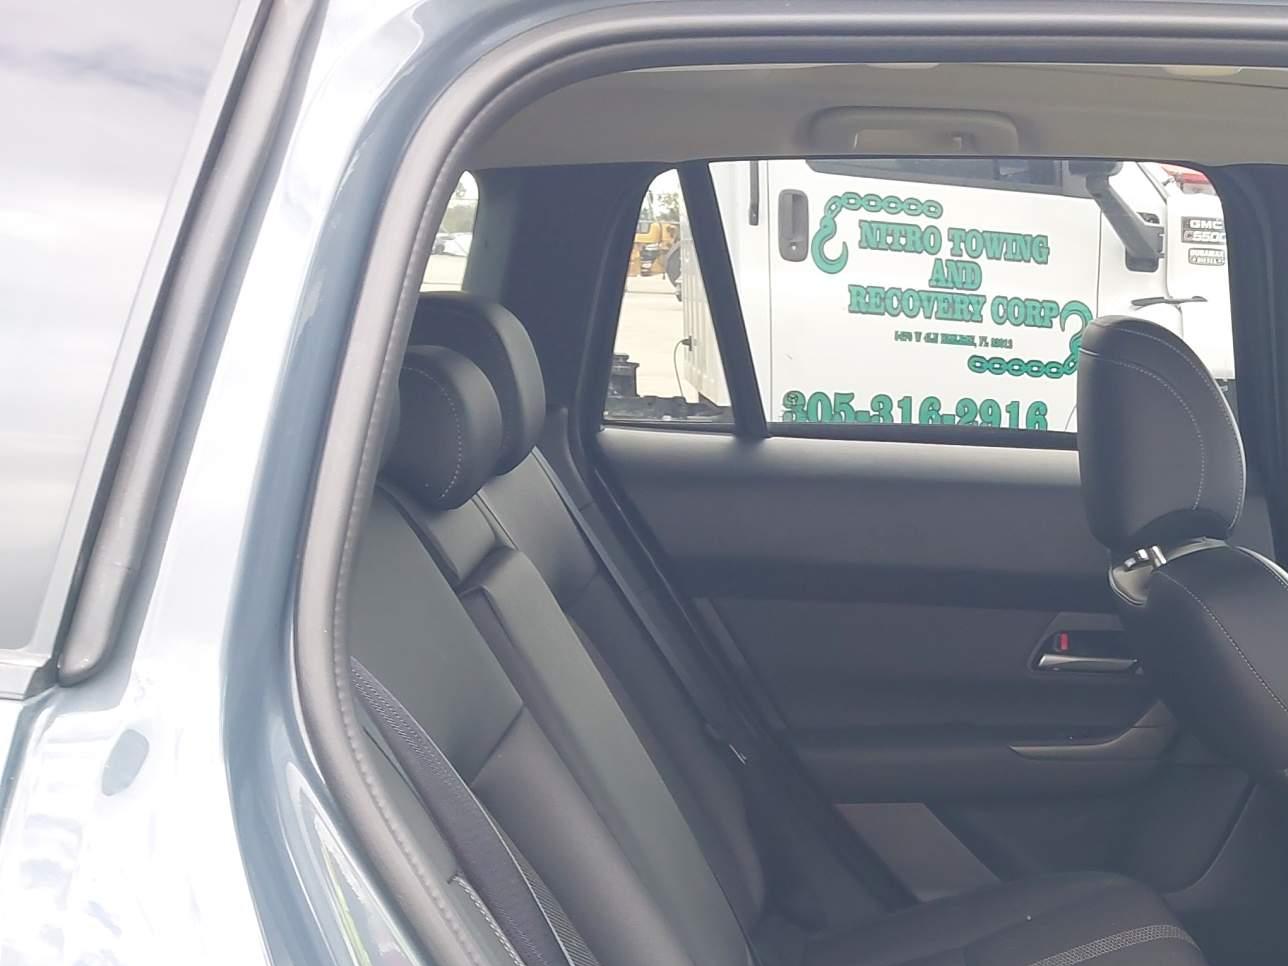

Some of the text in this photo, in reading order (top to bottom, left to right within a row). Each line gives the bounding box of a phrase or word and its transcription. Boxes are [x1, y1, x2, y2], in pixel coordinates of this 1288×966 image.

[859, 220, 1050, 264] NITRO TOWING
[1190, 219, 1224, 231] GMC
[929, 258, 982, 291] AND
[848, 284, 1060, 328] RECOVERY CORP
[782, 389, 1048, 431] 305-316-2916
